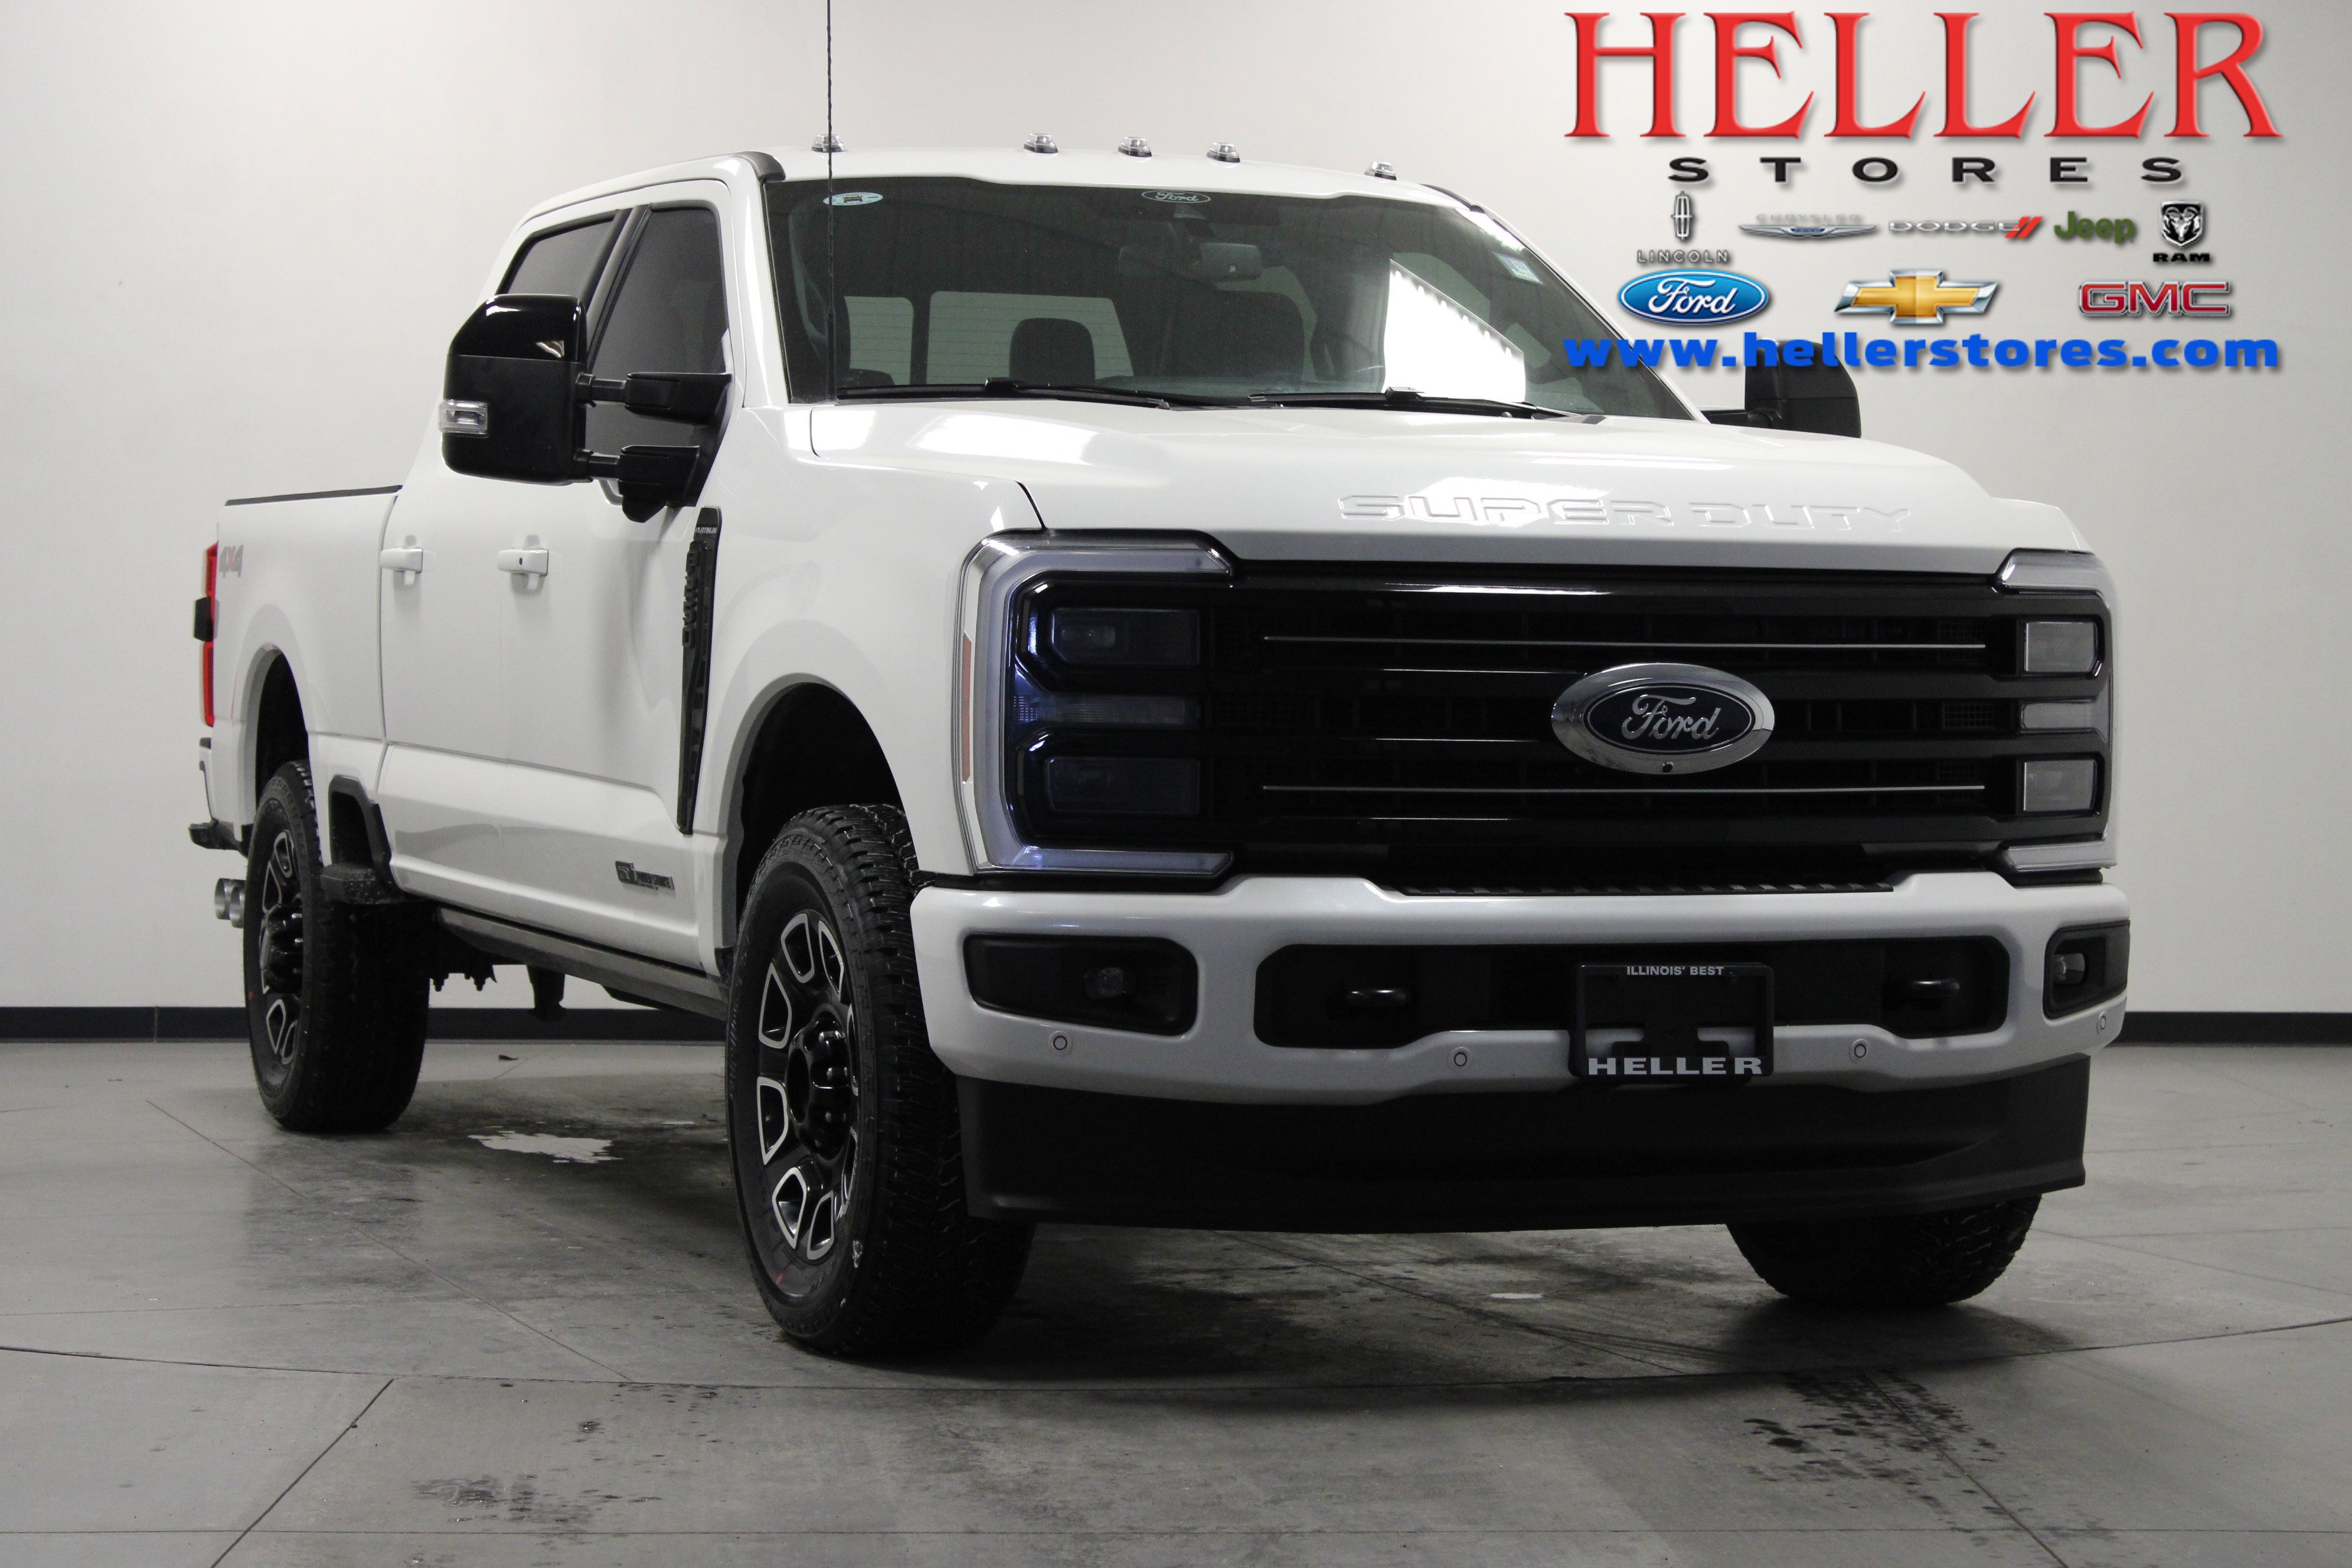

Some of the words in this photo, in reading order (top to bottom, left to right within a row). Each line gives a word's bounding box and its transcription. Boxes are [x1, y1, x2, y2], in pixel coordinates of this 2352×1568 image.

[1155, 191, 1199, 201] Ford
[1337, 495, 1675, 527] SUPER
[1688, 502, 1911, 533] DUTY
[1622, 694, 1721, 739] Ford
[1690, 966, 1724, 975] BEST
[1588, 1057, 1763, 1076] HELLER
